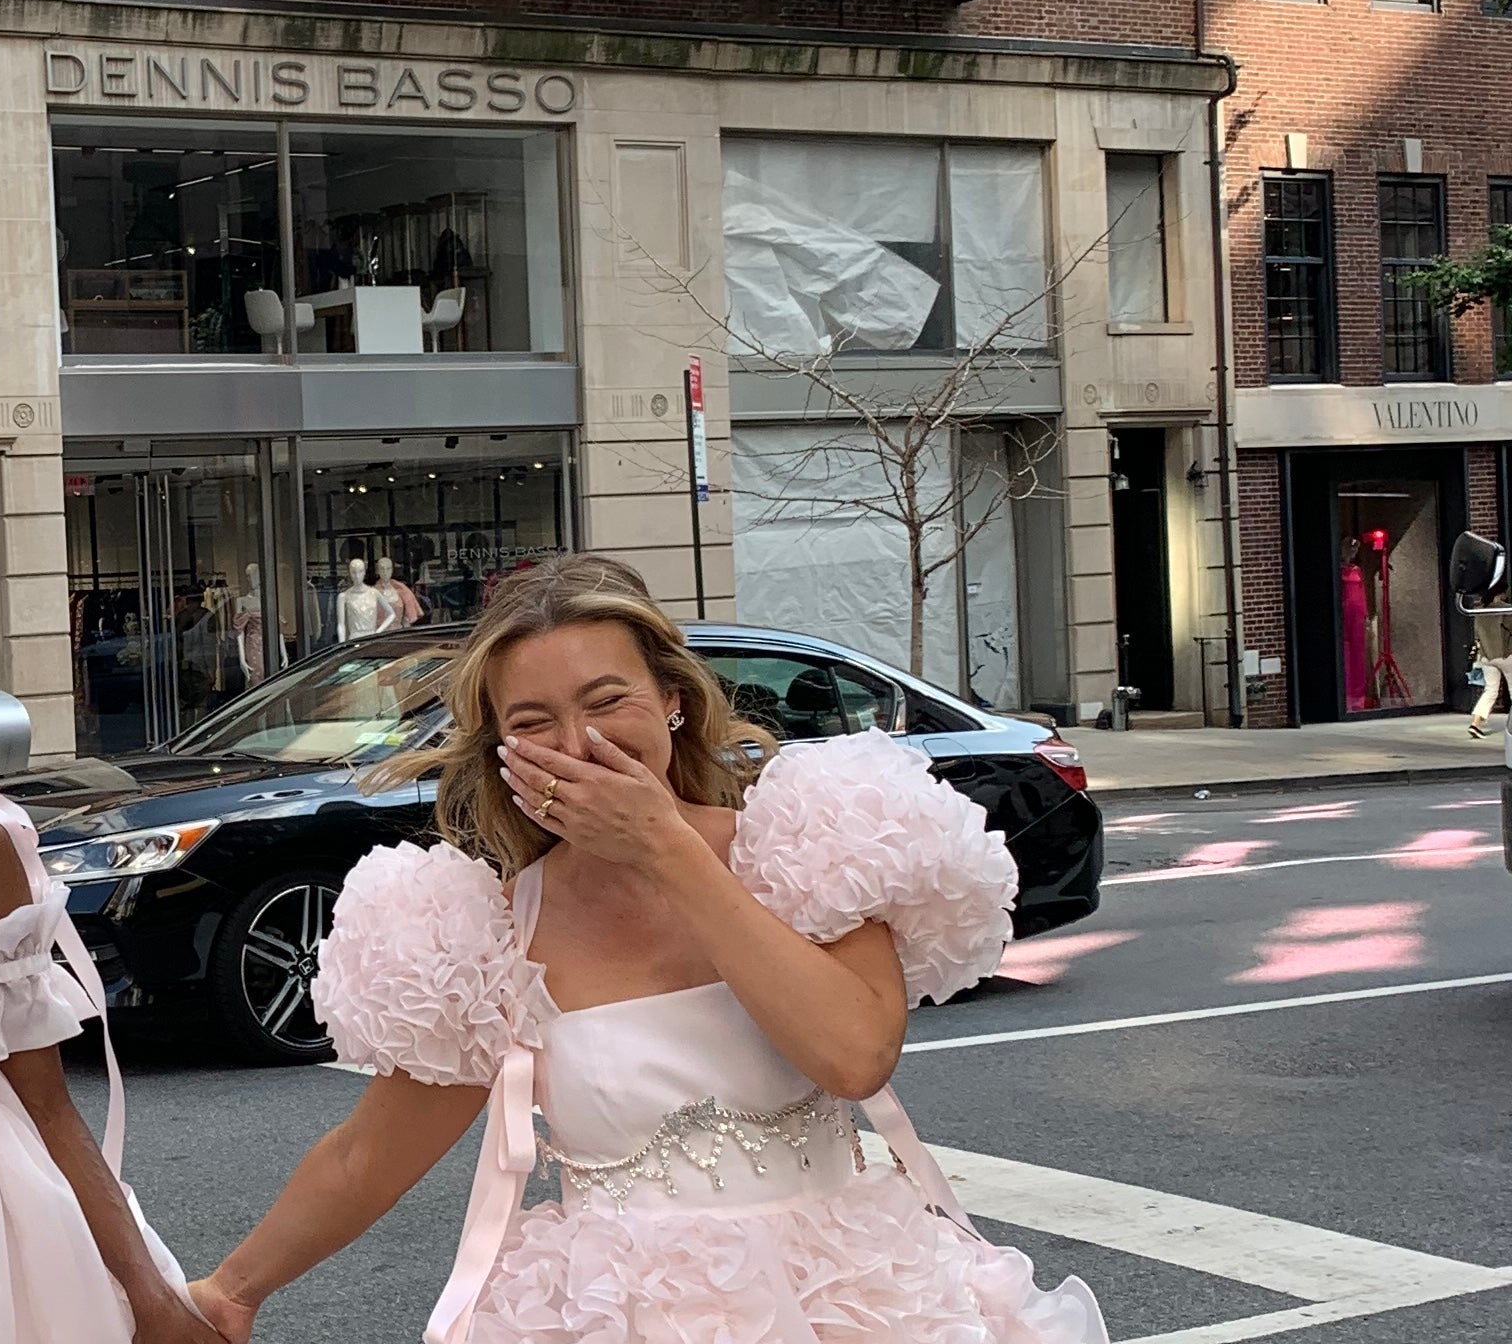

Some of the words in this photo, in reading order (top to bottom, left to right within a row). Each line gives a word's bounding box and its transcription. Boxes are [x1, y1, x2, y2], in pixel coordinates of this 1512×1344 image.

[46, 50, 310, 105] DENNIS
[337, 63, 577, 114] BASSO
[1372, 400, 1479, 429] VALENTINO
[447, 546, 510, 560] DENNIS
